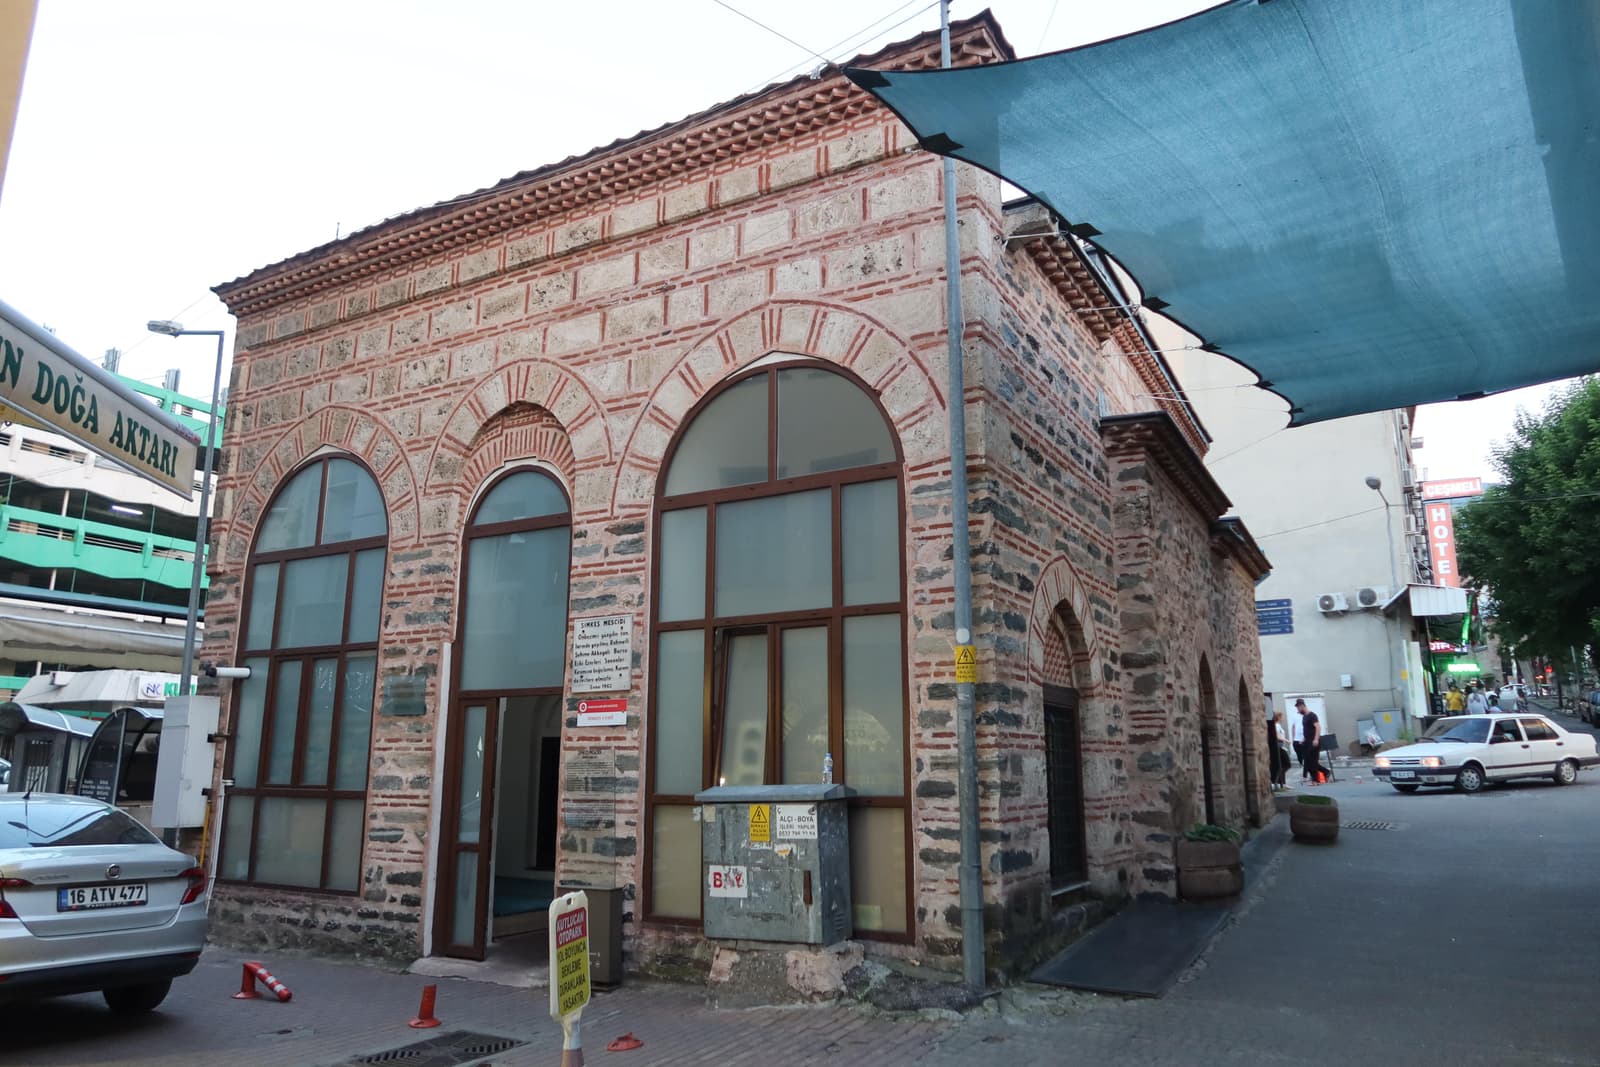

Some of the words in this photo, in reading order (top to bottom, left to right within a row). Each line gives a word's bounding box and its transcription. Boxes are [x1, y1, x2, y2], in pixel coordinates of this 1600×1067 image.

[0, 335, 24, 389] N
[32, 361, 99, 434] DOĞA
[109, 410, 179, 478] AKTARI
[780, 815, 793, 823] ALÇI
[797, 815, 814, 823] BOYA
[70, 889, 86, 904] 16
[90, 887, 116, 903] ATV
[120, 885, 144, 900] 477
[559, 927, 583, 945] OTOPARK
[561, 959, 582, 978] BEKLEME
[559, 973, 586, 997] DURAKLAMA
[563, 990, 585, 1010] YASAKTIR
